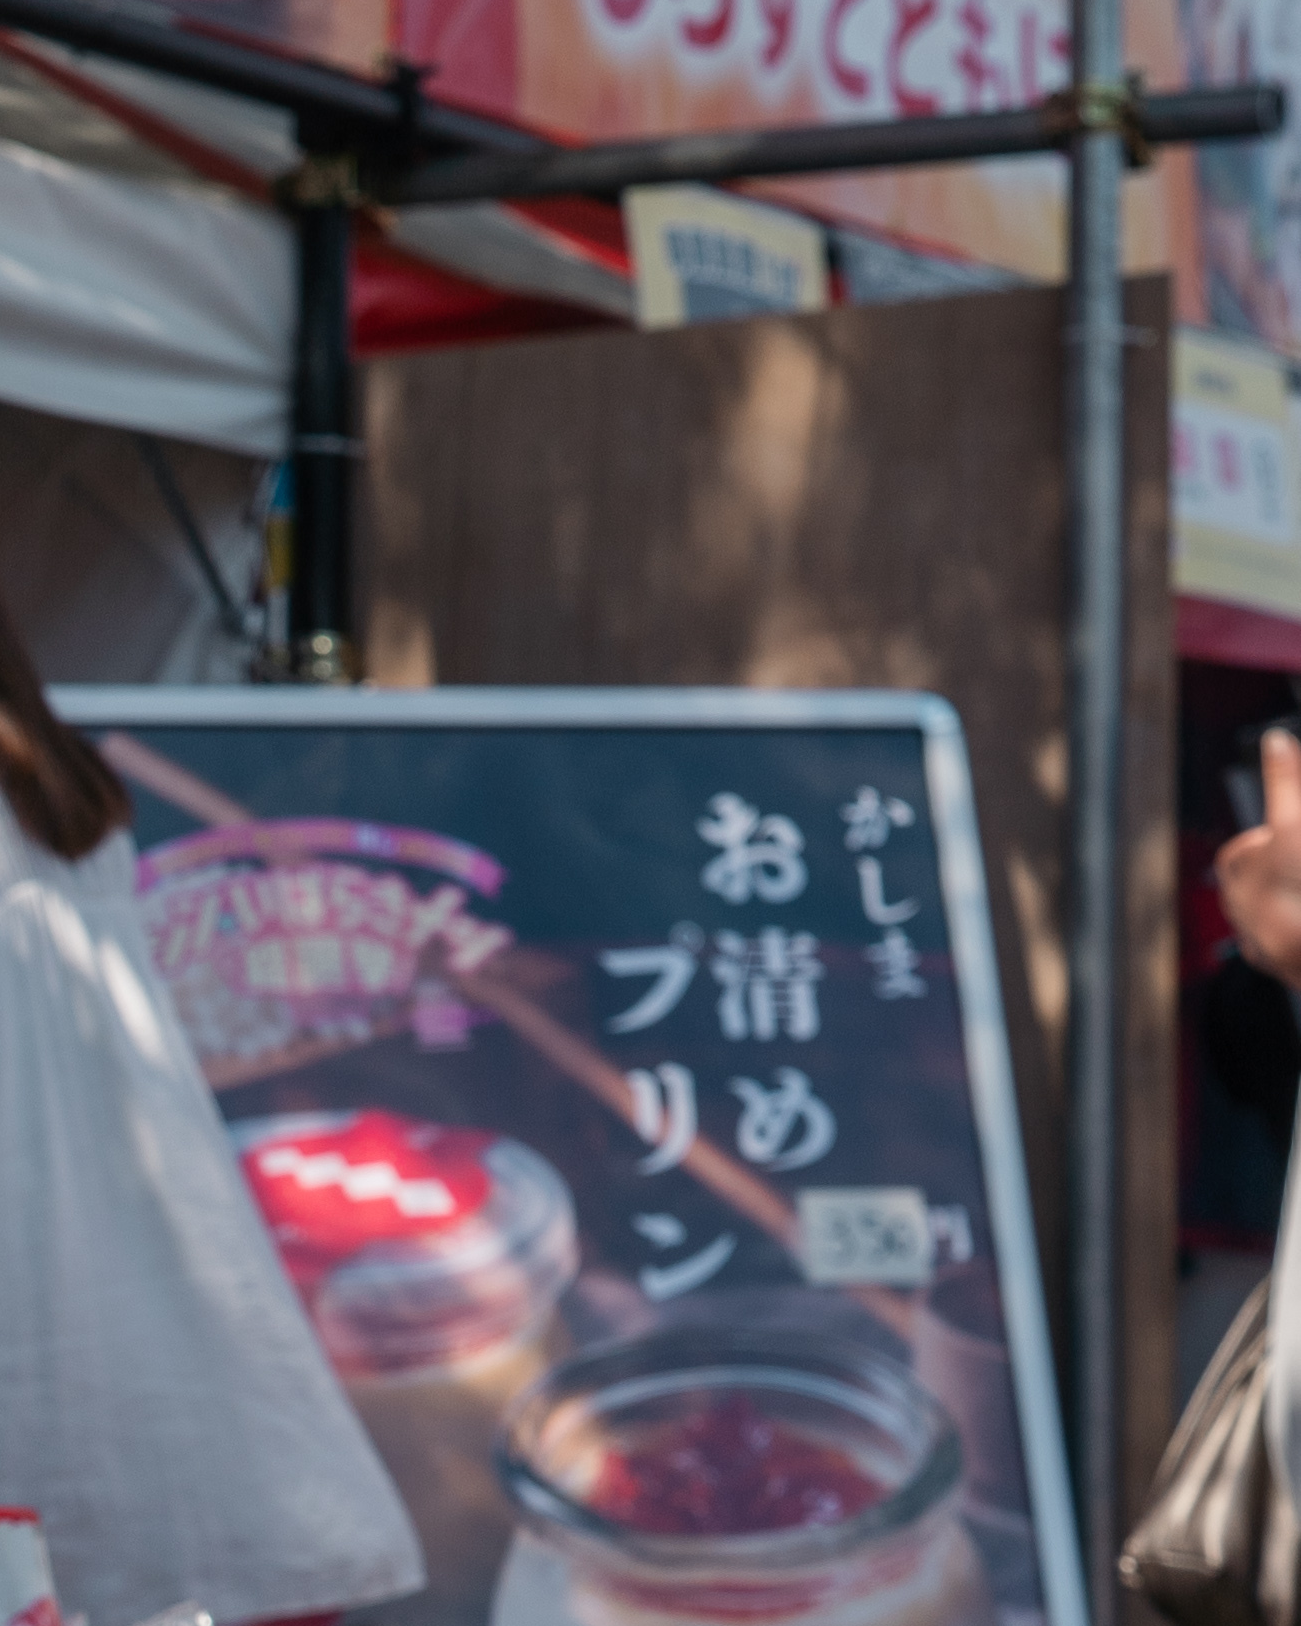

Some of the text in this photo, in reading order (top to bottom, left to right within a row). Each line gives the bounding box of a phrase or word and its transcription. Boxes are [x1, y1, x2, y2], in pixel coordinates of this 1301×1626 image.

[696, 790, 836, 1172] お清め
[840, 785, 927, 999] かしま
